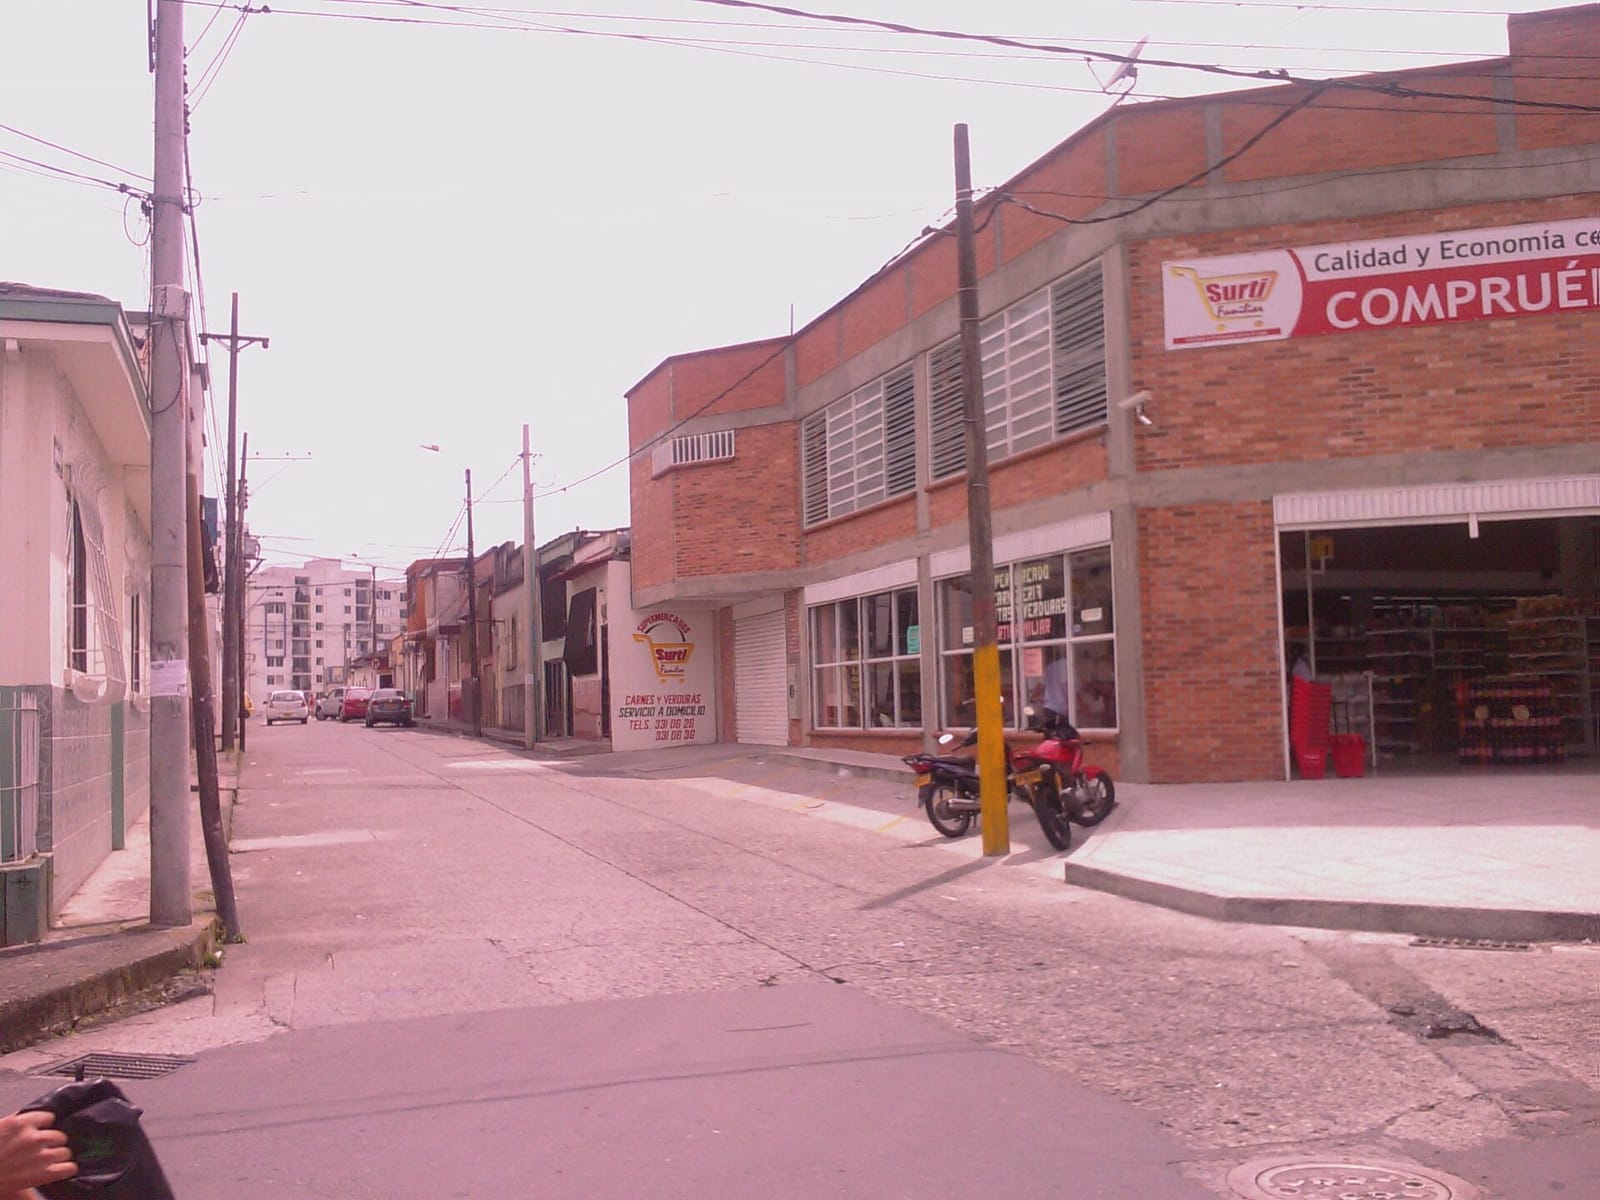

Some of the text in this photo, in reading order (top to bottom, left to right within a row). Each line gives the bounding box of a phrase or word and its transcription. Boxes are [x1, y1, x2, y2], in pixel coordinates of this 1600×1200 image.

[1314, 244, 1407, 273] Calidad
[1416, 247, 1430, 267] y
[1440, 230, 1566, 260] Economía
[1205, 277, 1268, 302] Surti
[625, 694, 654, 706] CARNES
[663, 693, 702, 705] VERDURAS
[618, 705, 706, 718] SERVICIO A DOMICILIO
[654, 719, 668, 730] 331
[655, 730, 669, 742] 331
